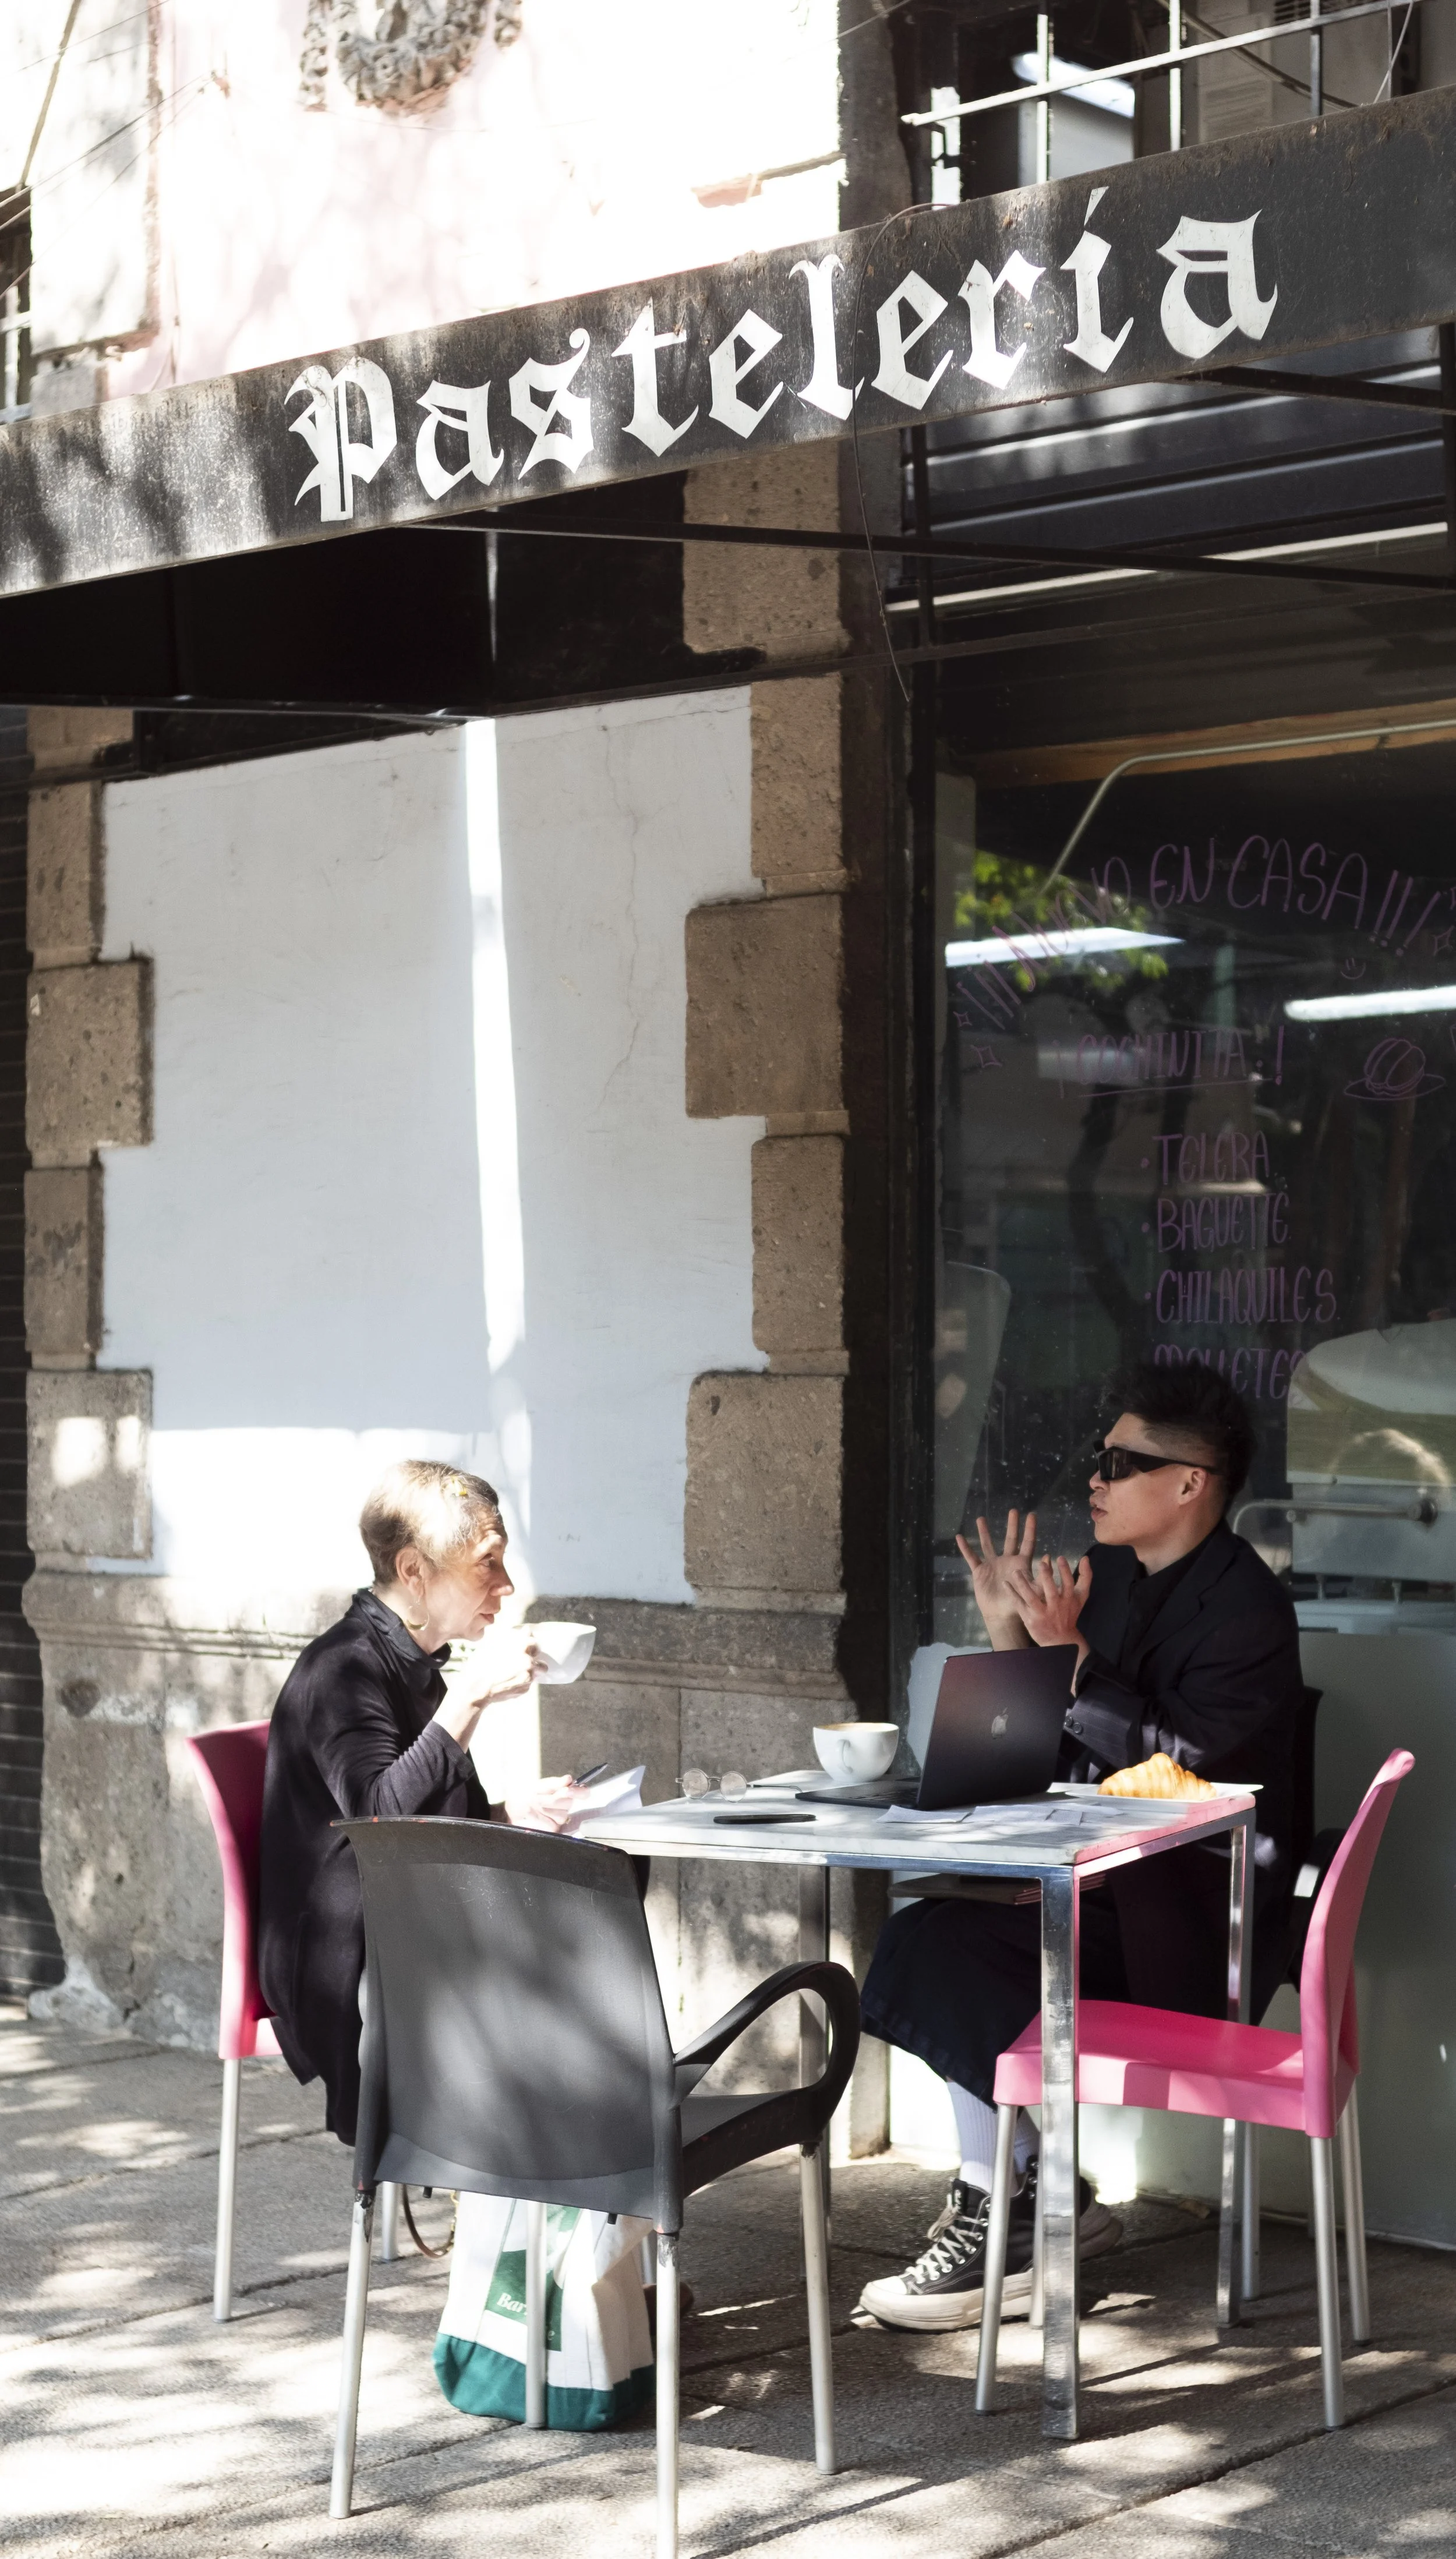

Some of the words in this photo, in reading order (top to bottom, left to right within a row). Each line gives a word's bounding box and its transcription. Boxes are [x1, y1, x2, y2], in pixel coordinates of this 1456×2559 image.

[284, 186, 1278, 522] Pastelería
[1150, 837, 1215, 911] EN
[1152, 1130, 1270, 1185] TELERA
[1157, 1191, 1290, 1253] BAGUETTE
[1156, 1266, 1337, 1325] CHILAQUILES
